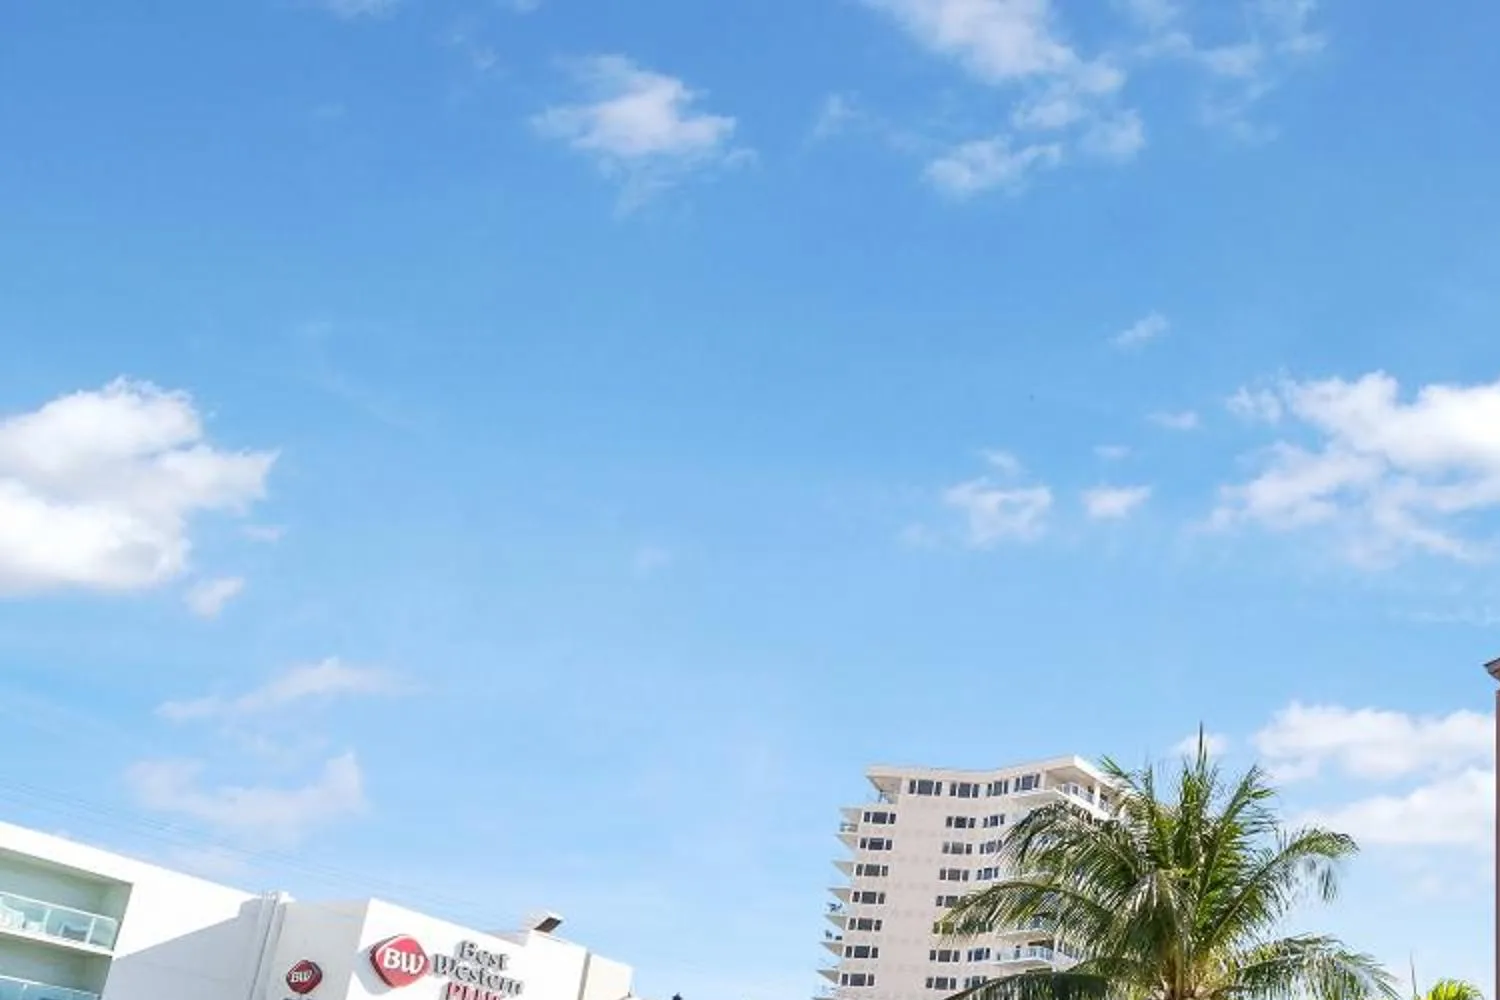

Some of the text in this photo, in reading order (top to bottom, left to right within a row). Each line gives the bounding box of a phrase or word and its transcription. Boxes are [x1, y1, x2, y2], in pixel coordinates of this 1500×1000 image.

[383, 947, 425, 975] BW
[456, 940, 510, 971] Best
[431, 953, 524, 997] Western
